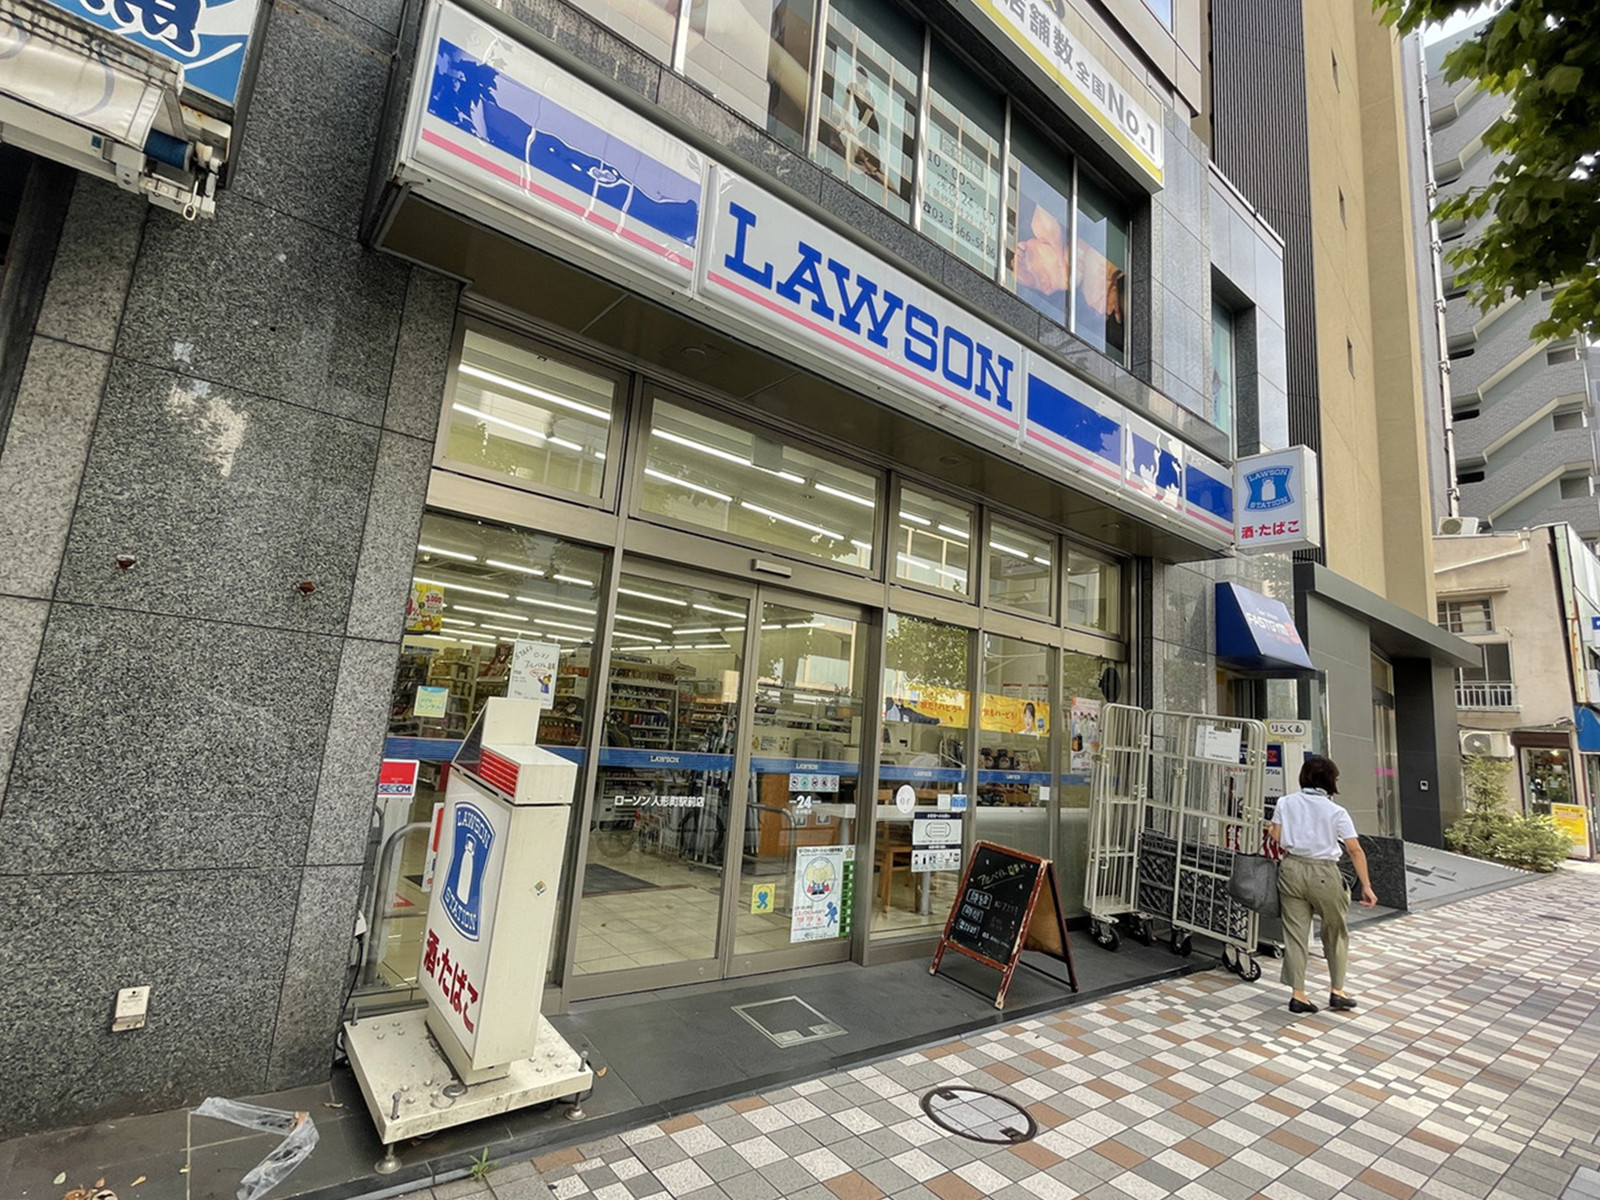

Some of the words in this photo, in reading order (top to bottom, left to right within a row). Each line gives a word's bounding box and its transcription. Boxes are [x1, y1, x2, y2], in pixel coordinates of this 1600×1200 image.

[724, 201, 1014, 412] LAWSON
[1249, 468, 1288, 482] LAWSON
[1249, 496, 1288, 509] STATION
[1271, 724, 1302, 734] りらくる
[380, 784, 411, 793] SECOM
[796, 794, 812, 809] 24
[457, 810, 492, 850] LAWSON
[445, 887, 477, 931] STATION
